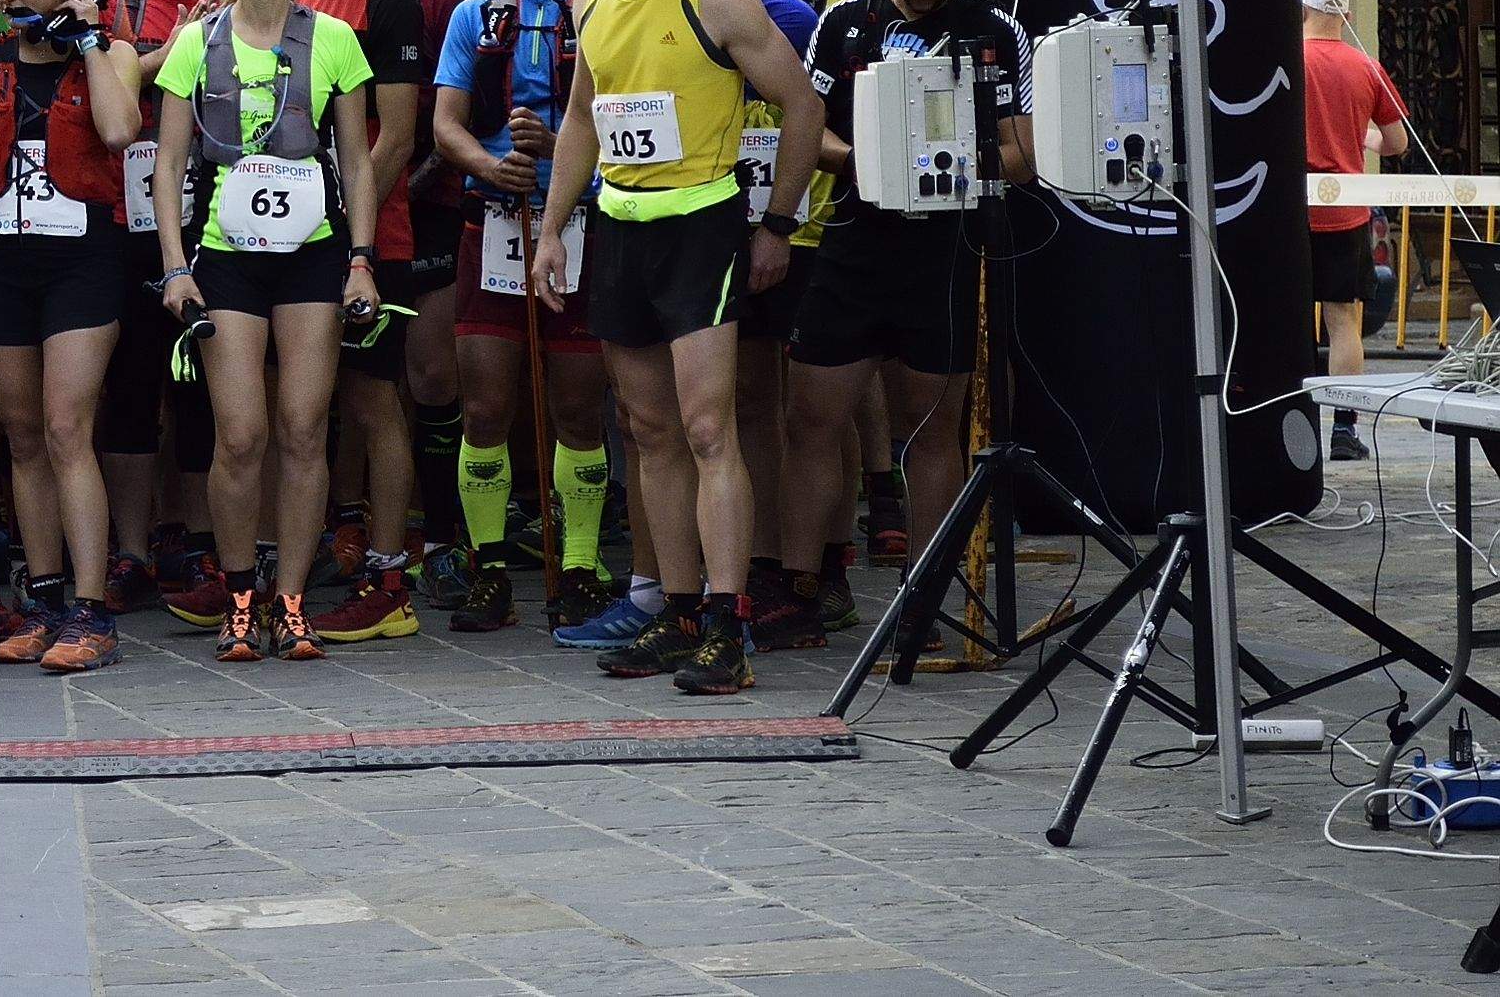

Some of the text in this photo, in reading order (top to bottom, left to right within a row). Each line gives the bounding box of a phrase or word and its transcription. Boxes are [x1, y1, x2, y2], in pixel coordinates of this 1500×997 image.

[602, 99, 665, 114] INTERSPORT
[609, 129, 656, 160] 103
[239, 162, 313, 178] INTERSPORT
[17, 174, 55, 202] 43
[251, 188, 292, 219] 63
[1246, 725, 1283, 735] FINITO
